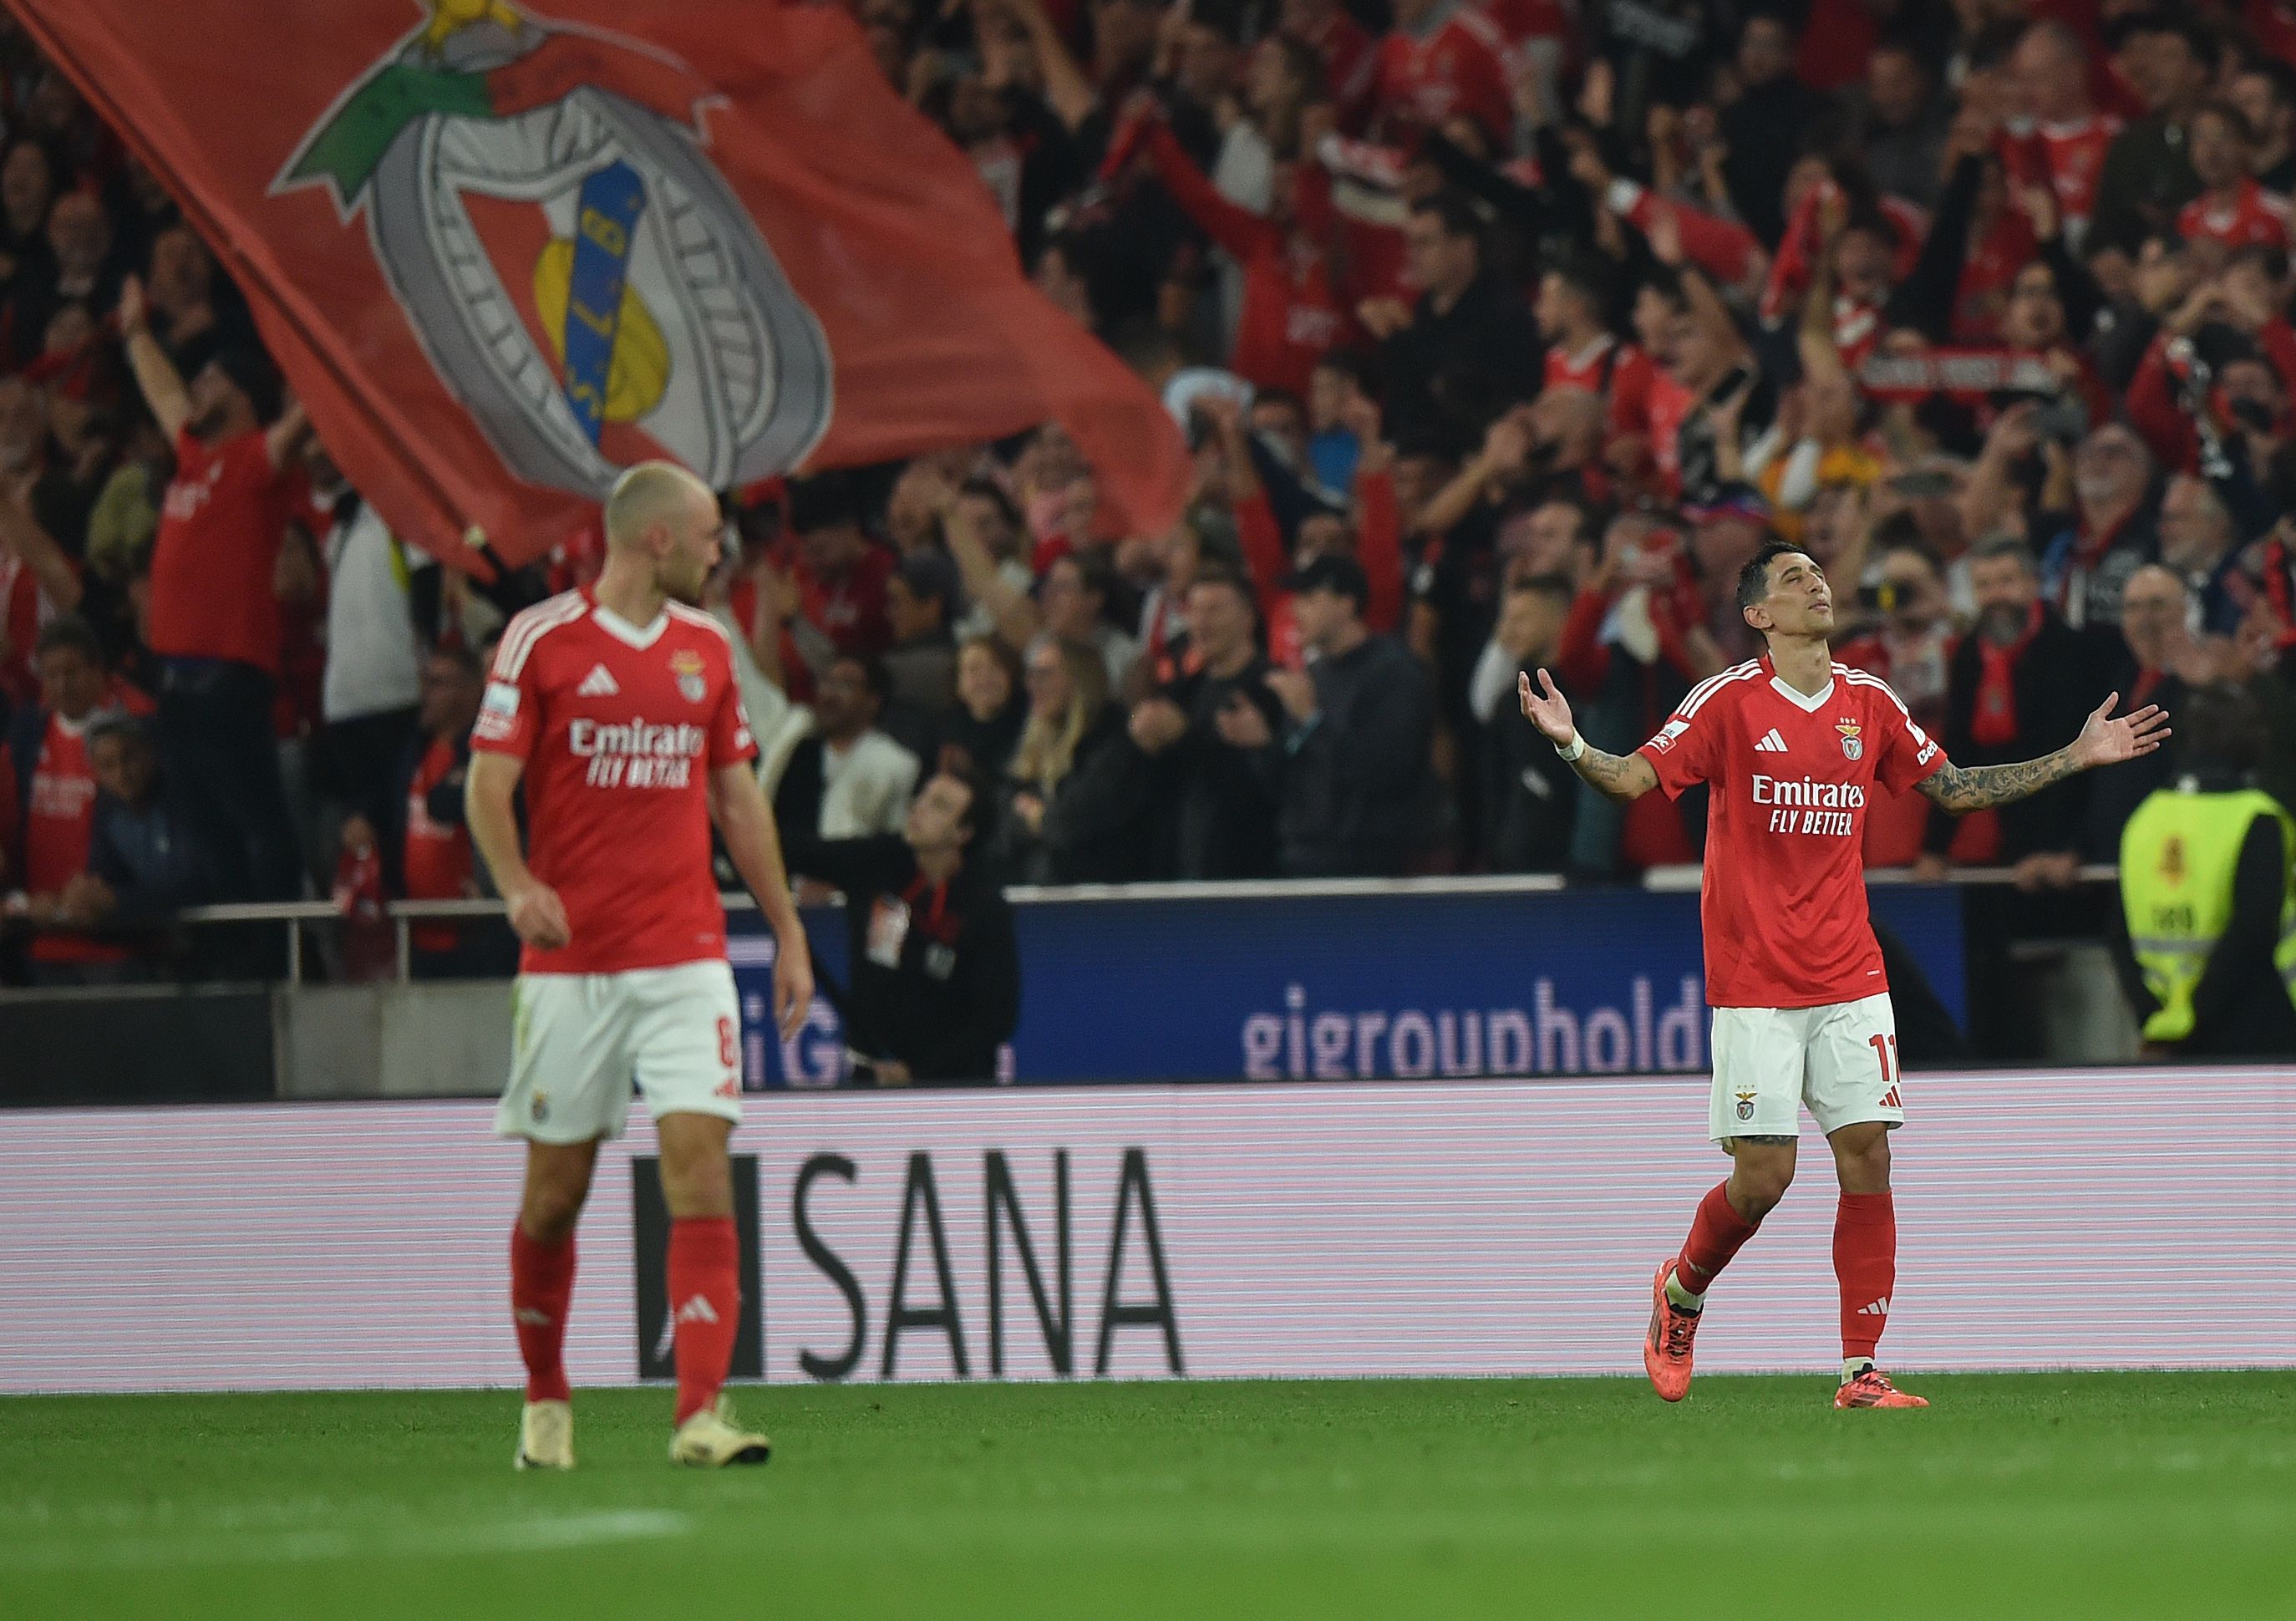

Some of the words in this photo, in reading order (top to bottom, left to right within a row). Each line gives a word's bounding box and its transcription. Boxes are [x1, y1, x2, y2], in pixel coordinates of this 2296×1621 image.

[1751, 774, 1865, 809] Emirates
[1769, 809, 1800, 834] FLY
[1801, 810, 1853, 836] BETTER
[1242, 975, 1711, 1081] gigrouphold
[1869, 1034, 1901, 1084] 11
[790, 1147, 1186, 1381] SANA
